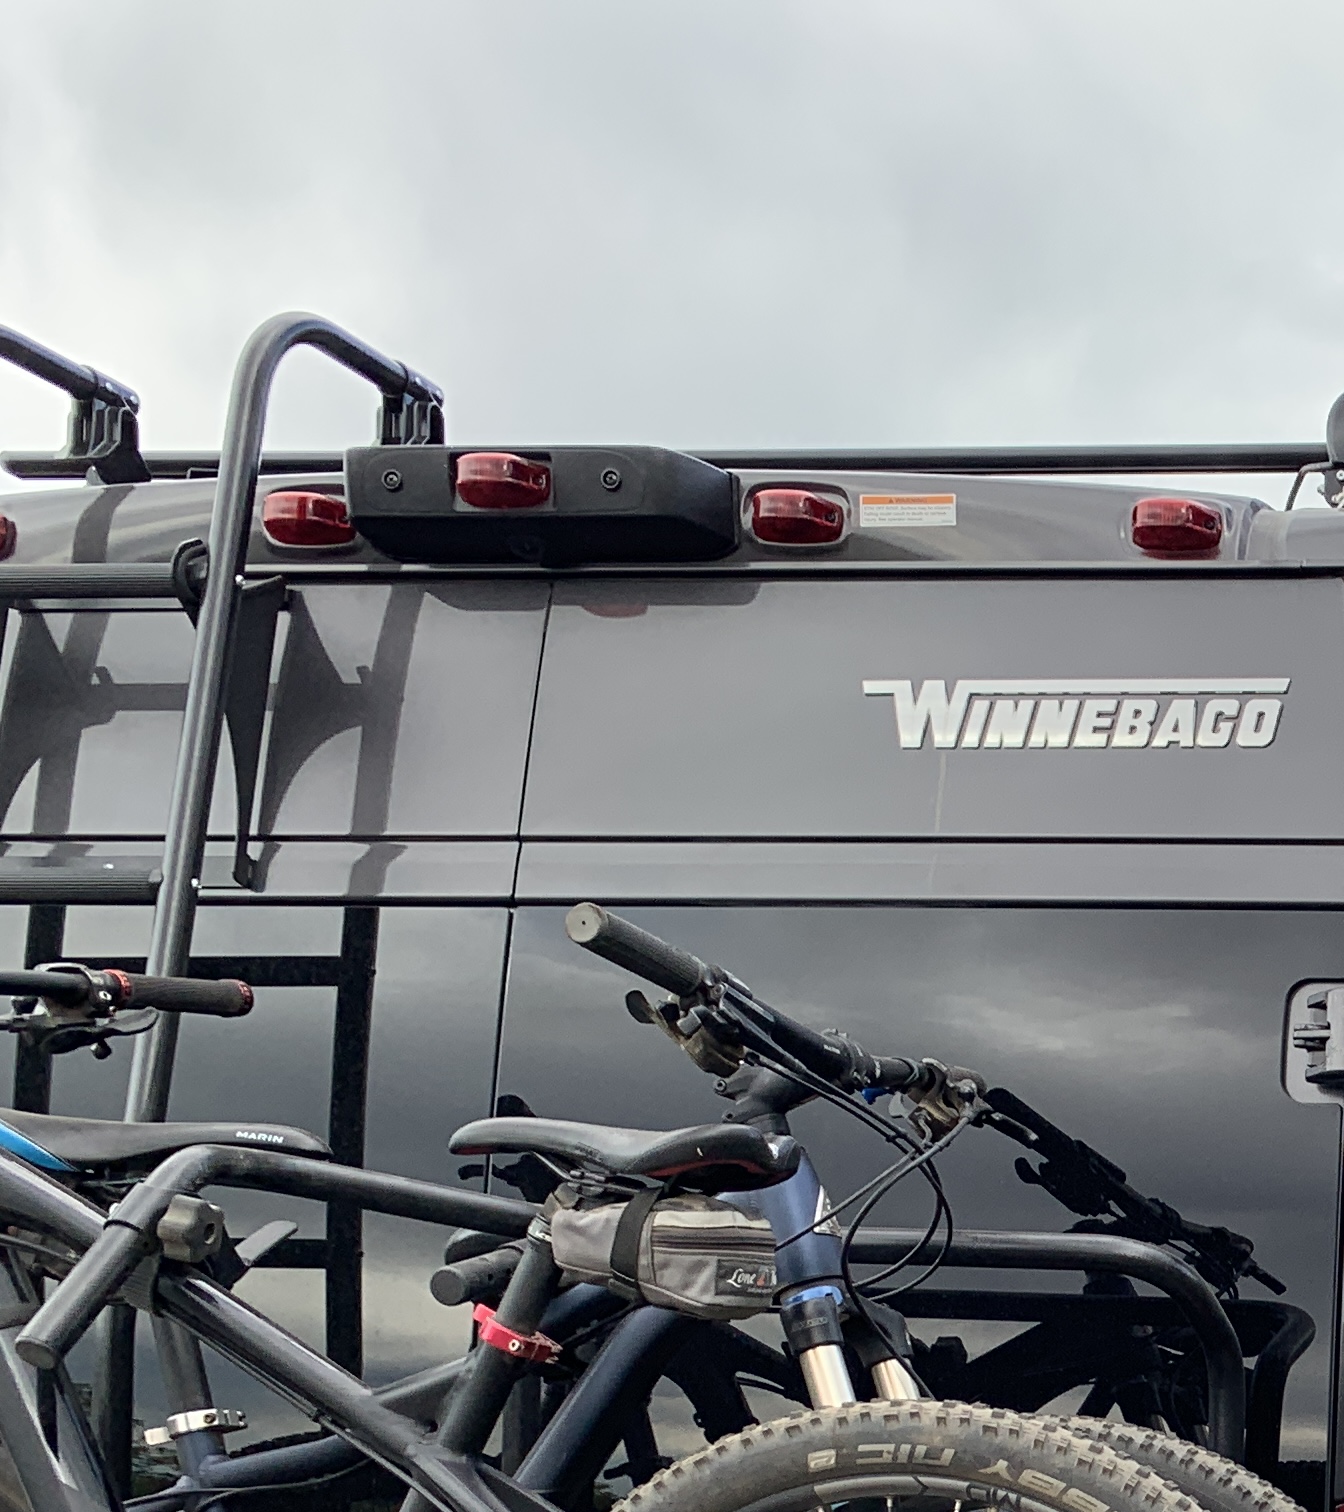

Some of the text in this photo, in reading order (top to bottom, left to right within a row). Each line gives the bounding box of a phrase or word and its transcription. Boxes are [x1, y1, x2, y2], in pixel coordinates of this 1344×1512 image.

[862, 677, 1291, 750] WINNEBAGO
[235, 1130, 284, 1144] MARIN
[726, 1267, 757, 1289] Lone
